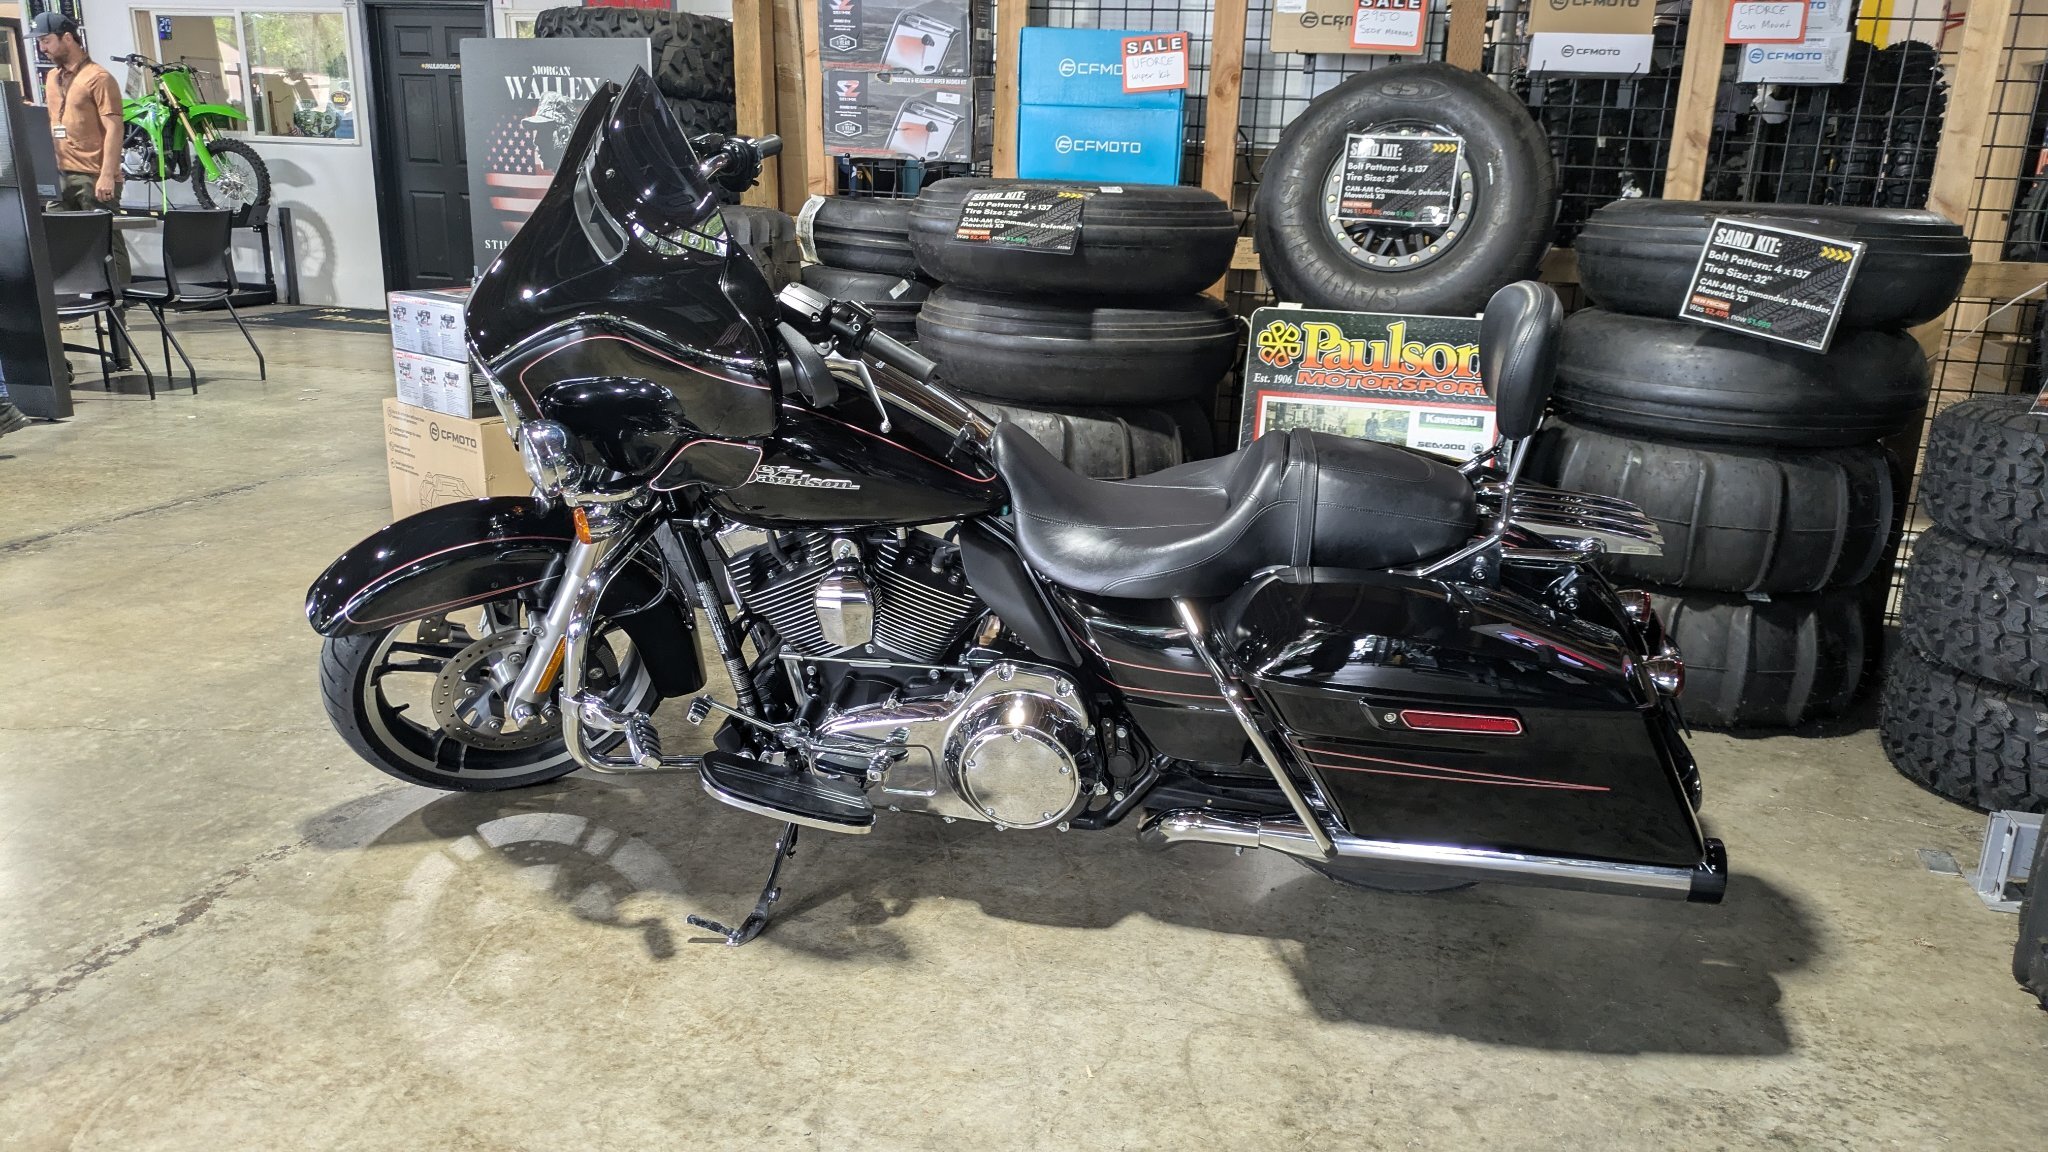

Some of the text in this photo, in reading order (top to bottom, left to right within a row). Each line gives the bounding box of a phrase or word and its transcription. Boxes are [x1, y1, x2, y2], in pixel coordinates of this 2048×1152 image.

[1360, 0, 1420, 9] SALE
[1126, 37, 1182, 54] SALE
[1576, 48, 1620, 56] CFMOTO
[1767, 52, 1822, 60] CFMOTO
[532, 65, 571, 76] MORGAN
[1077, 63, 1123, 76] CFMO
[504, 75, 601, 101] WALLEN
[1073, 140, 1141, 154] CFMOTO
[1382, 143, 1403, 157] KIT:
[1347, 162, 1365, 171] Bolt
[1365, 163, 1399, 172] Pattern:
[1414, 165, 1429, 173] 137
[1346, 172, 1363, 181] Tire
[1364, 174, 1385, 182] Size:
[972, 191, 1027, 200] SAND KIT:
[1375, 187, 1417, 196] Commander,
[994, 218, 1039, 229] Commander,
[1040, 223, 1075, 231] Defender,
[484, 239, 508, 250] STI
[1715, 228, 1783, 254] SAND KIT:
[1708, 250, 1730, 261] Bolt
[1730, 254, 1772, 272] Pattern:
[1773, 265, 1782, 273] 4
[1792, 269, 1812, 280] 137
[1704, 262, 1773, 285] Tire Size: 32"
[1696, 285, 1748, 303] Maverick X3
[1699, 277, 1832, 315] CAN-AM Commander, Defender,
[1689, 304, 1704, 312] Was
[1253, 372, 1293, 385] Est. 1906
[1425, 413, 1478, 427] Kawasaki
[440, 430, 477, 449] CFMOTO
